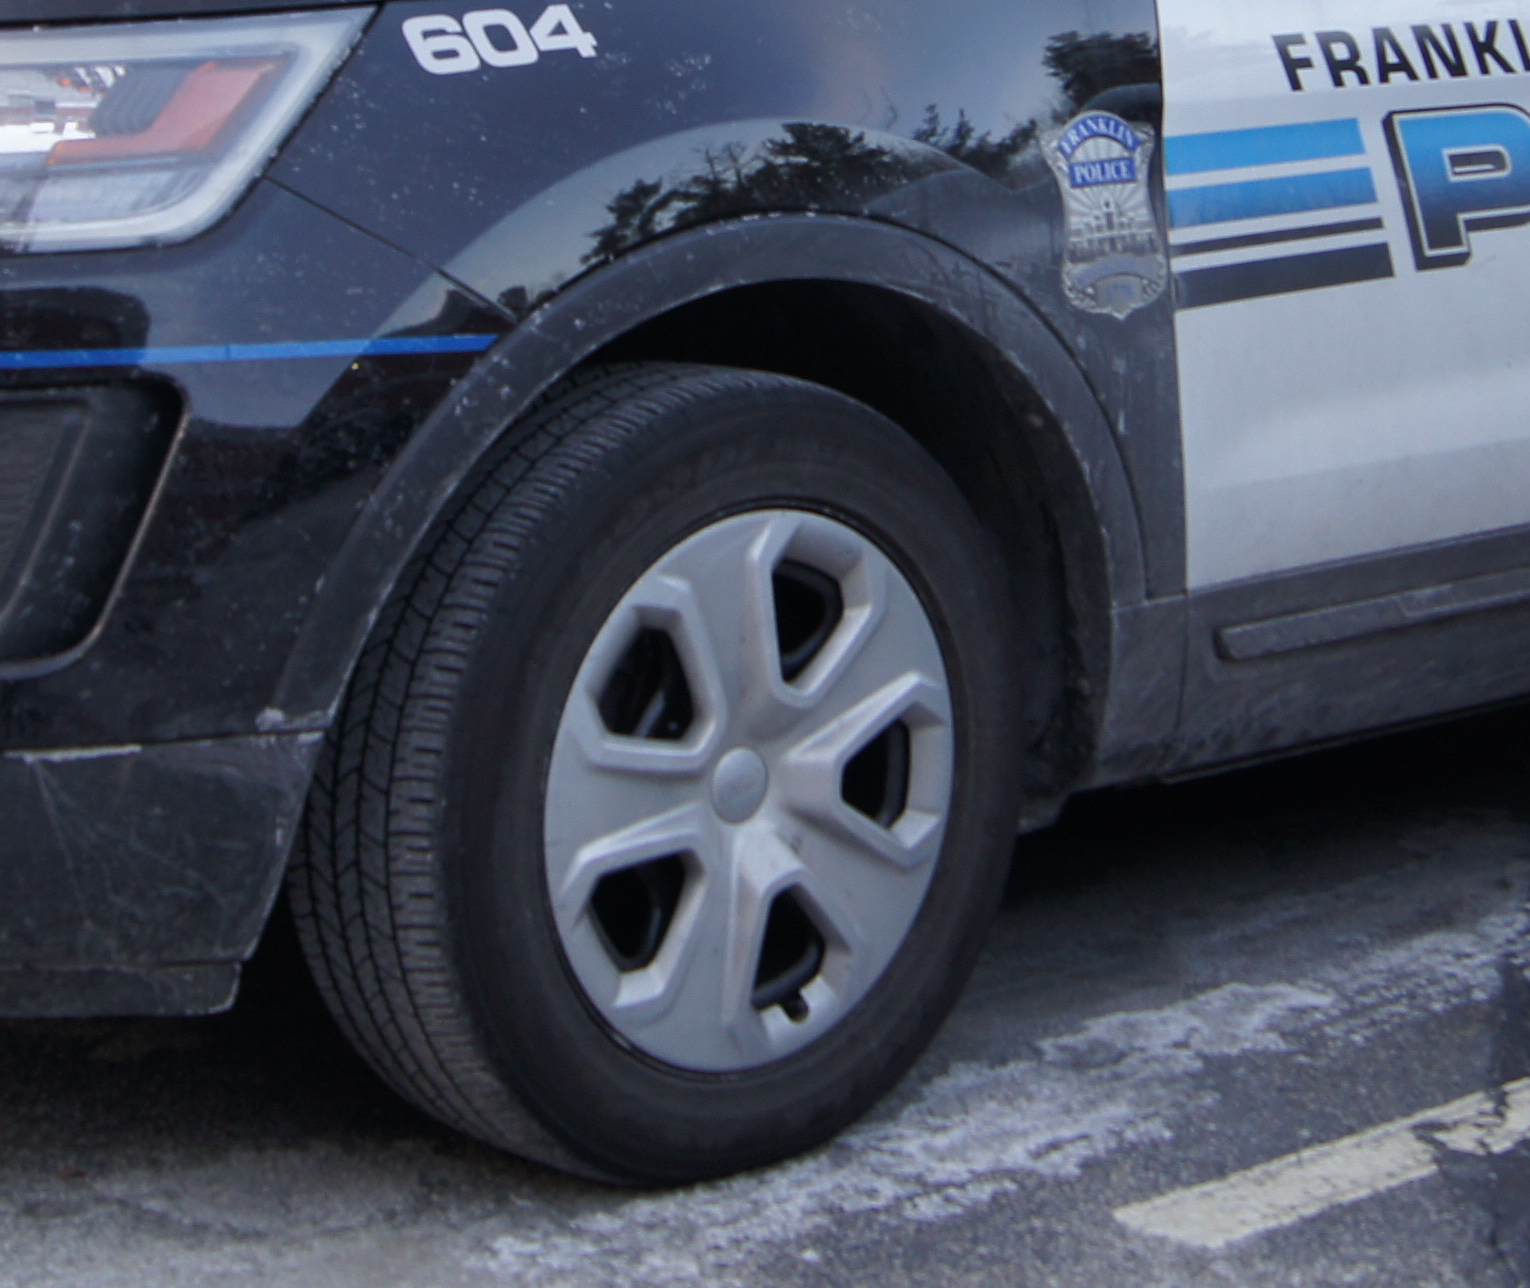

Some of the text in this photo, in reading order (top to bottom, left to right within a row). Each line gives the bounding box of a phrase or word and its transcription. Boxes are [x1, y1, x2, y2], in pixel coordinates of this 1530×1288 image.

[402, 3, 597, 75] 604
[1060, 115, 1136, 157] FRANKLIN
[1073, 161, 1131, 184] POLICE
